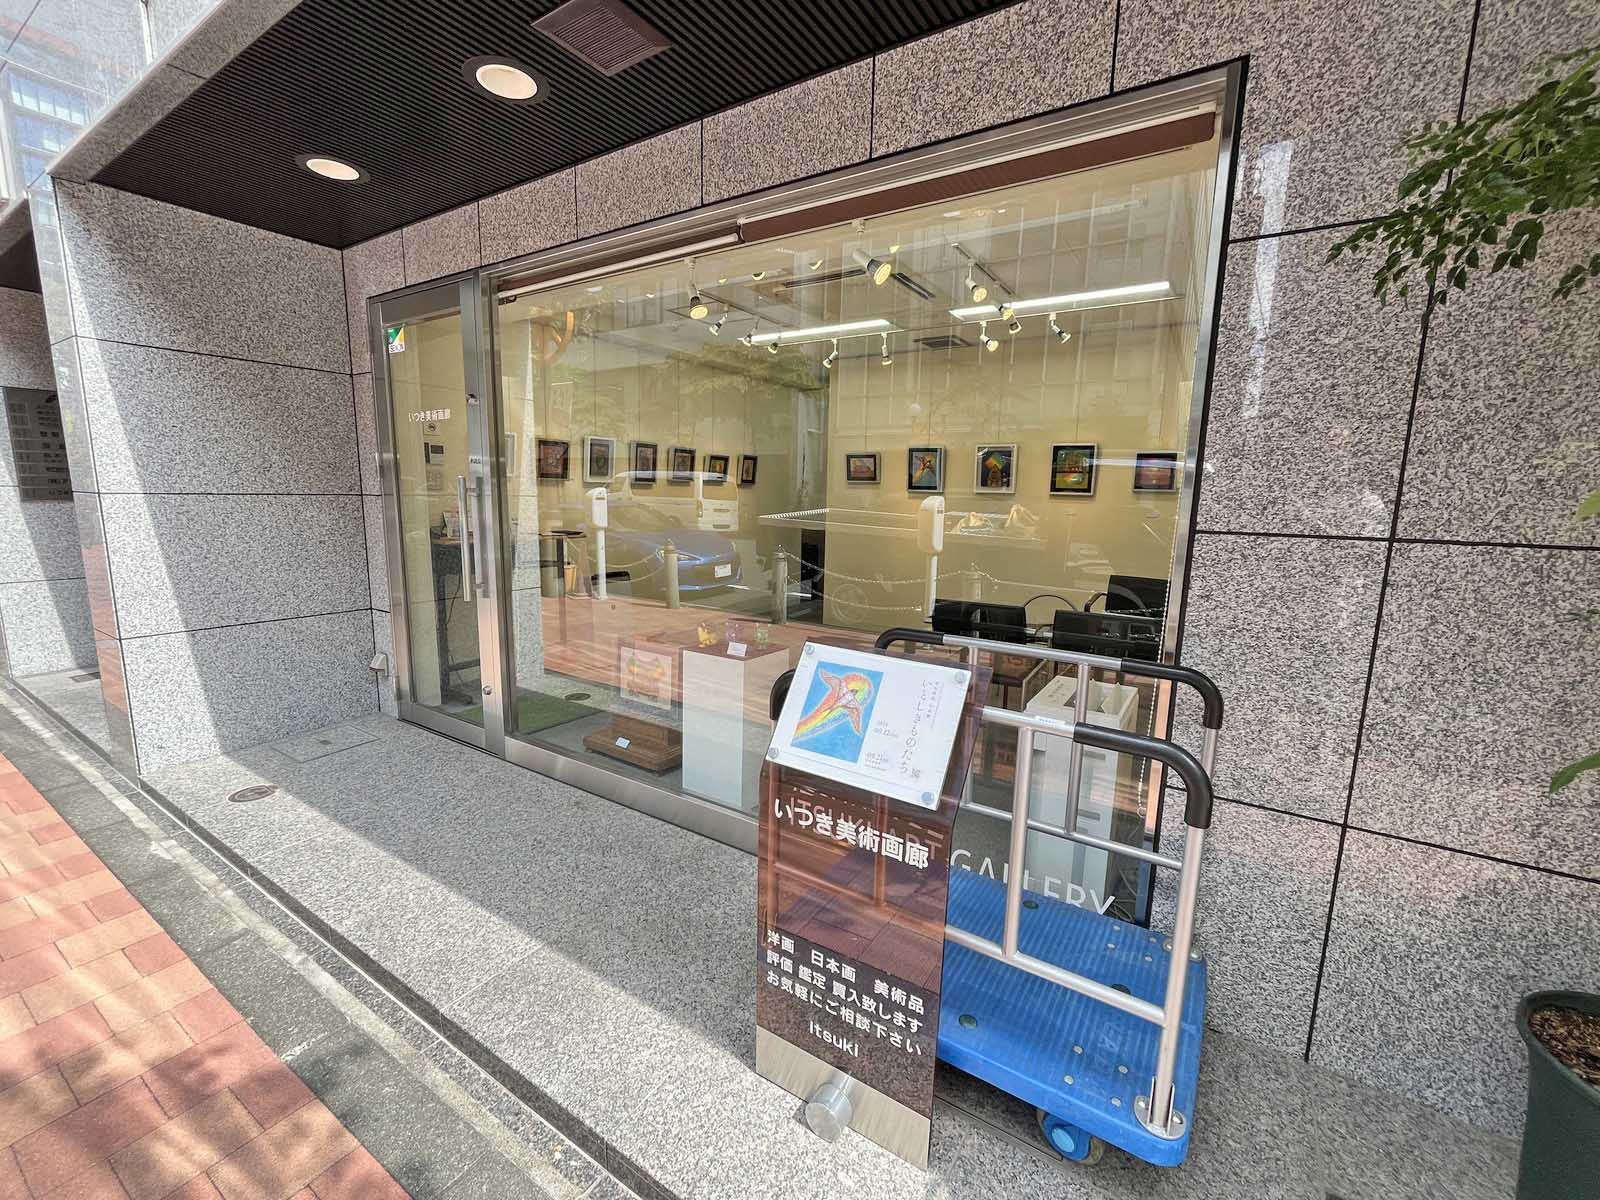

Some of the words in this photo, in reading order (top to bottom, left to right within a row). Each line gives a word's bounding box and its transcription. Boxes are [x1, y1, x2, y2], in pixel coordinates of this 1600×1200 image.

[774, 798, 930, 869] いつき美術画廊
[766, 949, 793, 975] 評価
[798, 963, 827, 990] 鑑定
[832, 979, 924, 1034] 買入致します
[766, 970, 922, 1056] お気軽にご相談下さい
[767, 930, 795, 954] 洋画
[811, 949, 857, 983] 日本画
[873, 979, 925, 1015] 美術品
[809, 1020, 860, 1058] Itsuki
